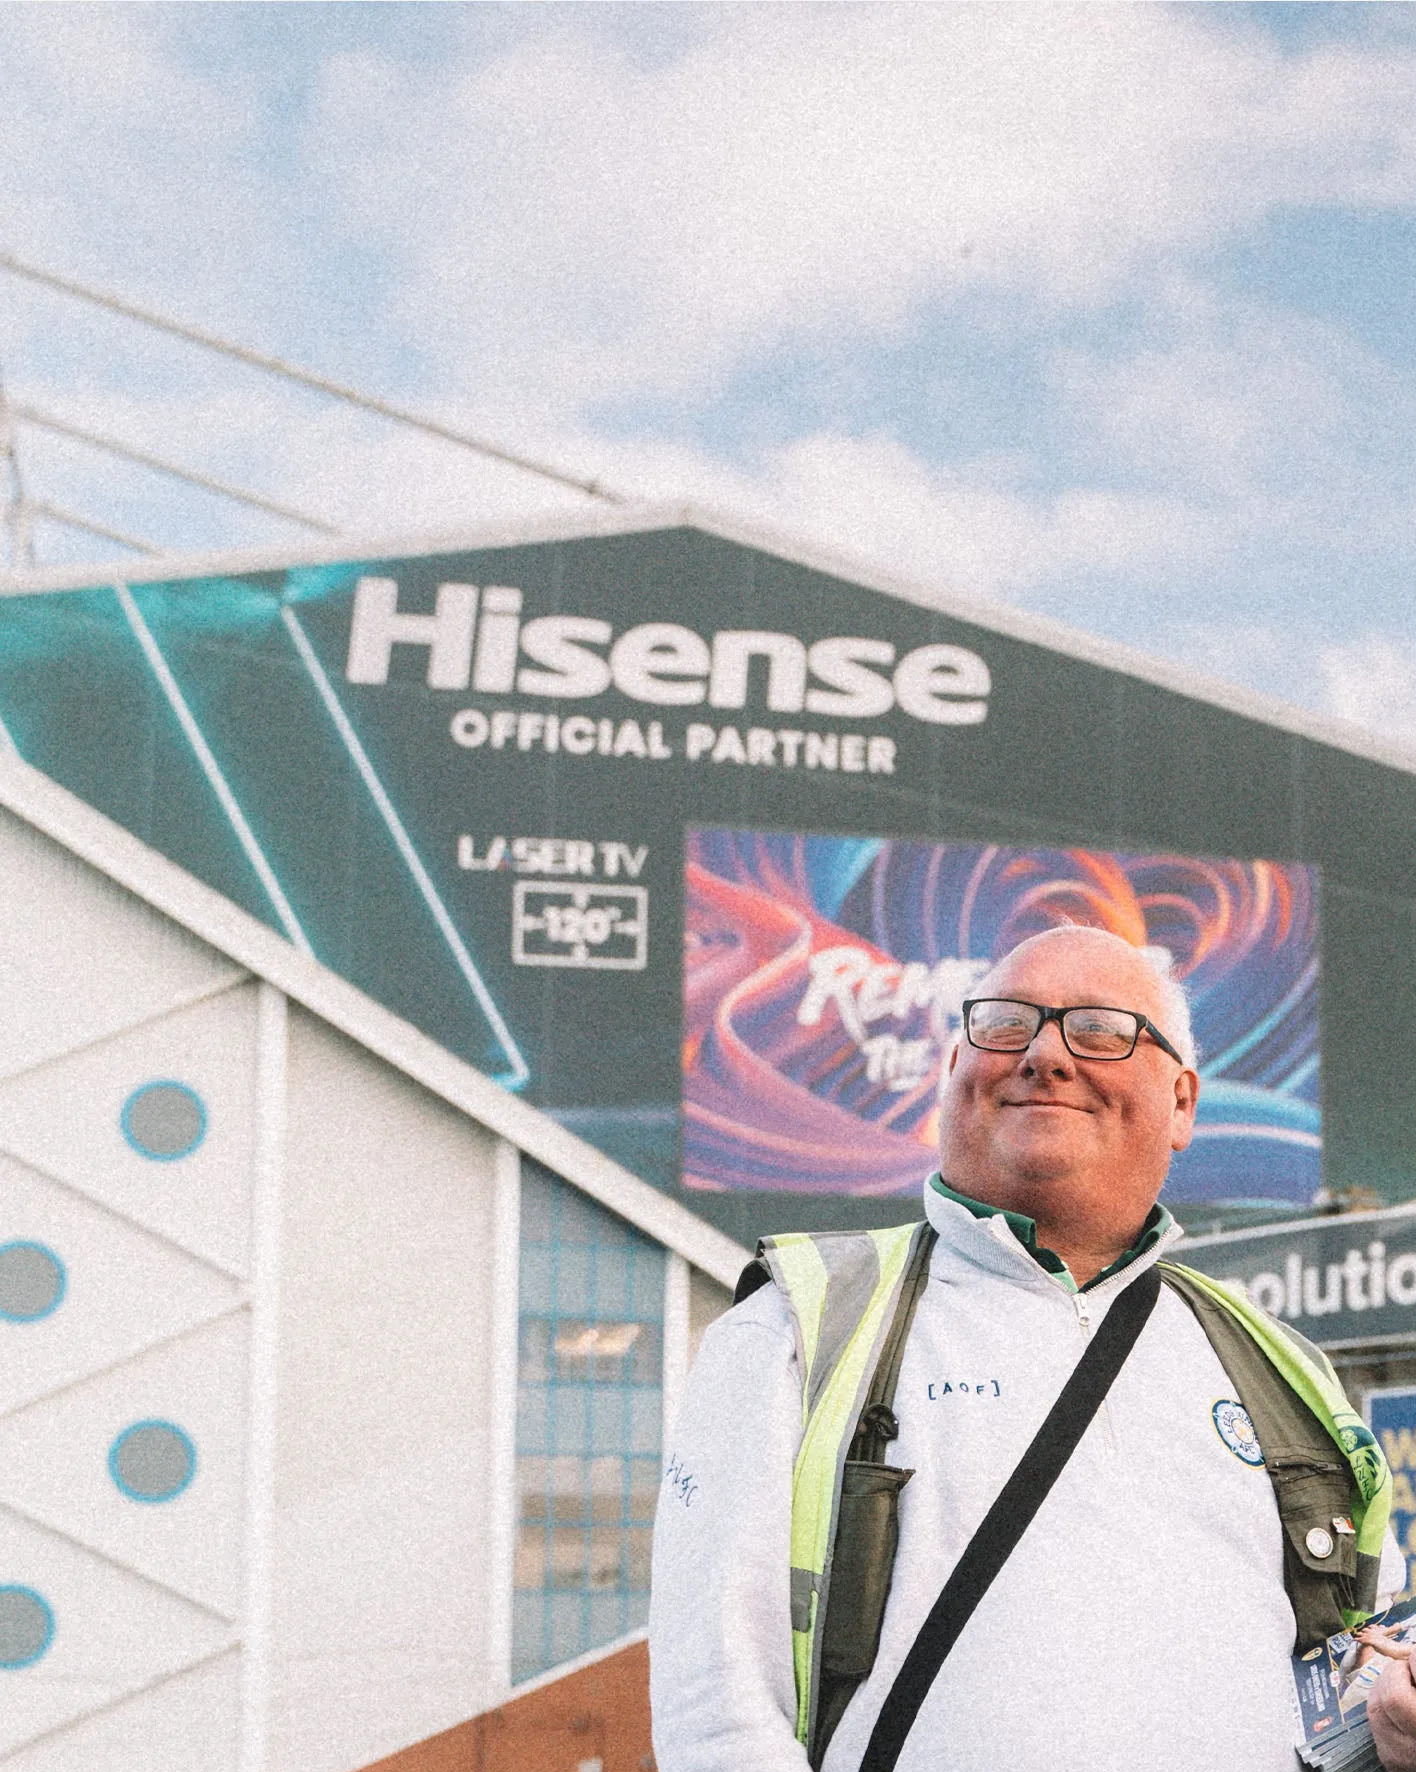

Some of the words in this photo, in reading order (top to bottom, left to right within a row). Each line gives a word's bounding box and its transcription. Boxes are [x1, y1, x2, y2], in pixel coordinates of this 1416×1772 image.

[347, 577, 992, 726] Hisense
[450, 708, 672, 761] OFFICIAL
[686, 722, 898, 775] PARTNER
[598, 839, 650, 878] TV
